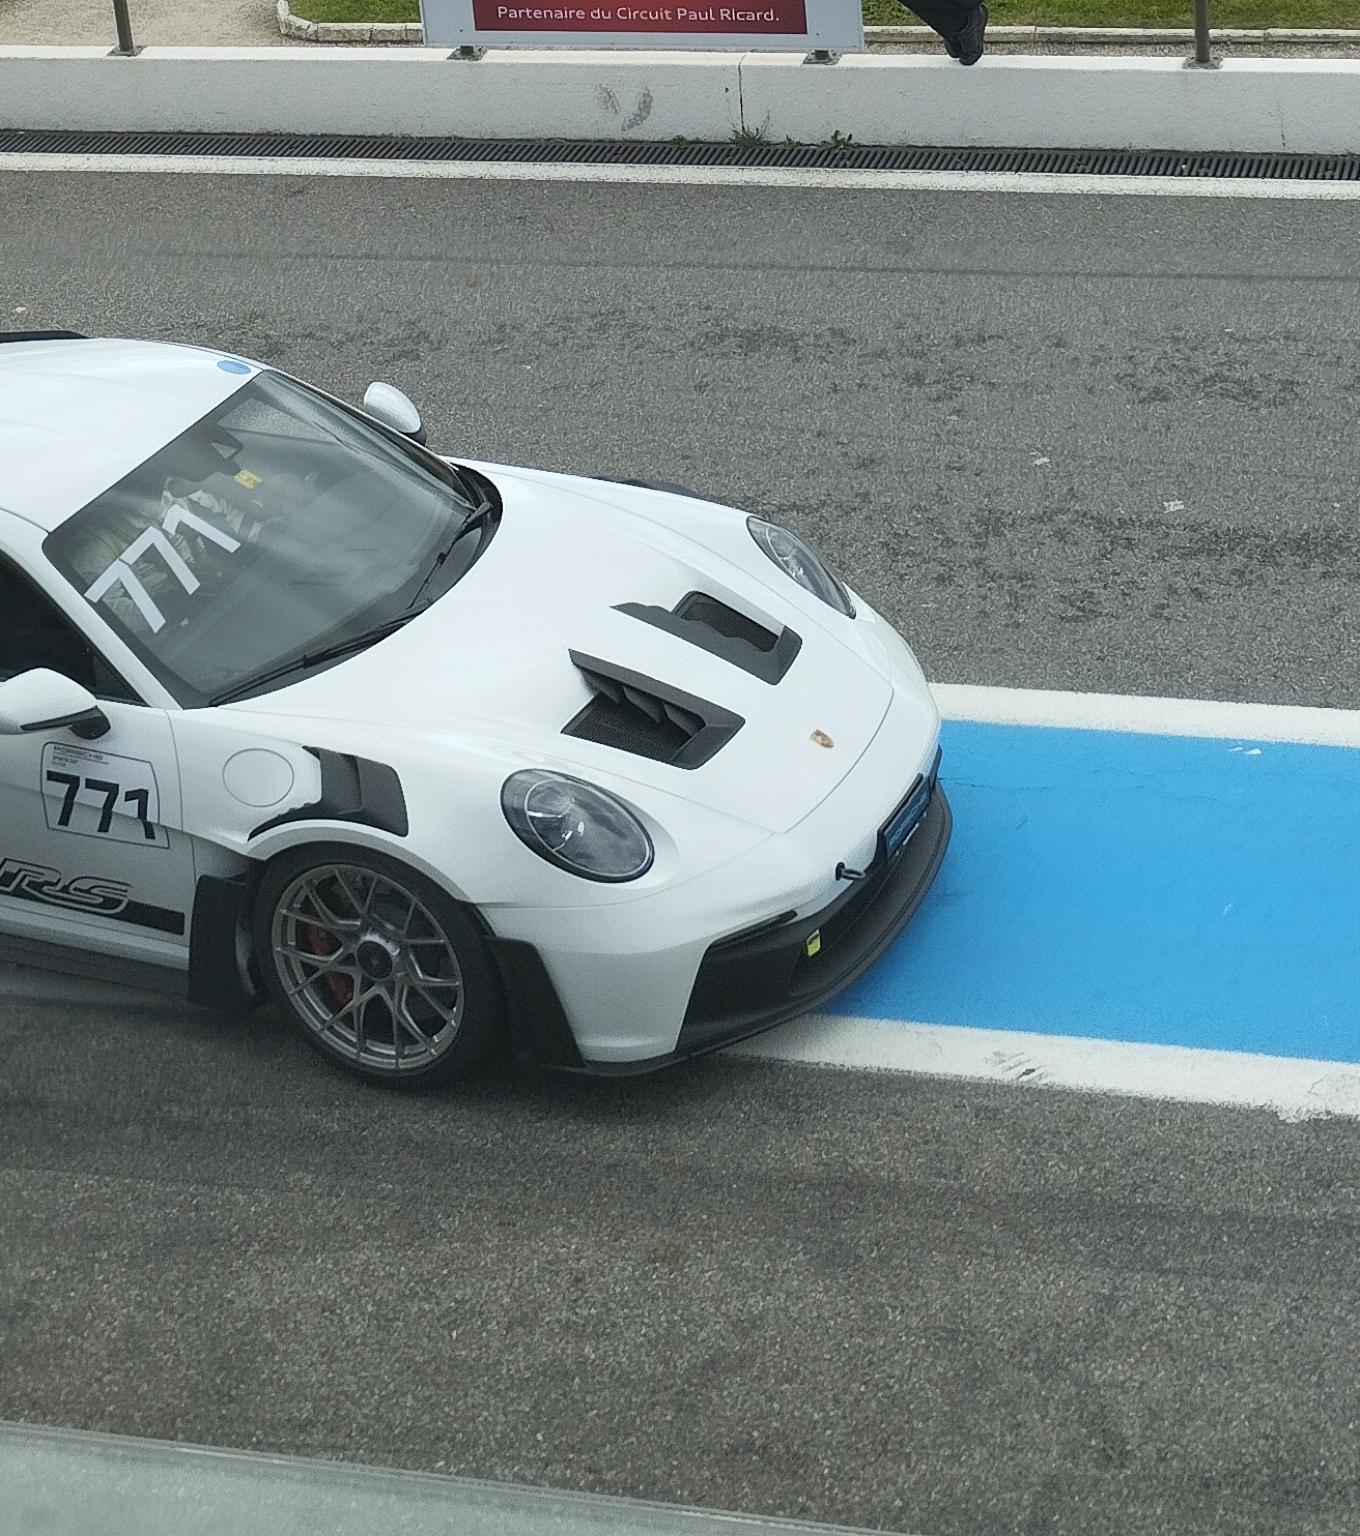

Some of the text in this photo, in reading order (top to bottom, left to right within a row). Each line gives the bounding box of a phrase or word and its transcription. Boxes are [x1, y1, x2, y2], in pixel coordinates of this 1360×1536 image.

[497, 5, 780, 23] Partenaire du Circuit Paul Ricard.
[84, 503, 240, 634] 771
[46, 769, 156, 840] 771
